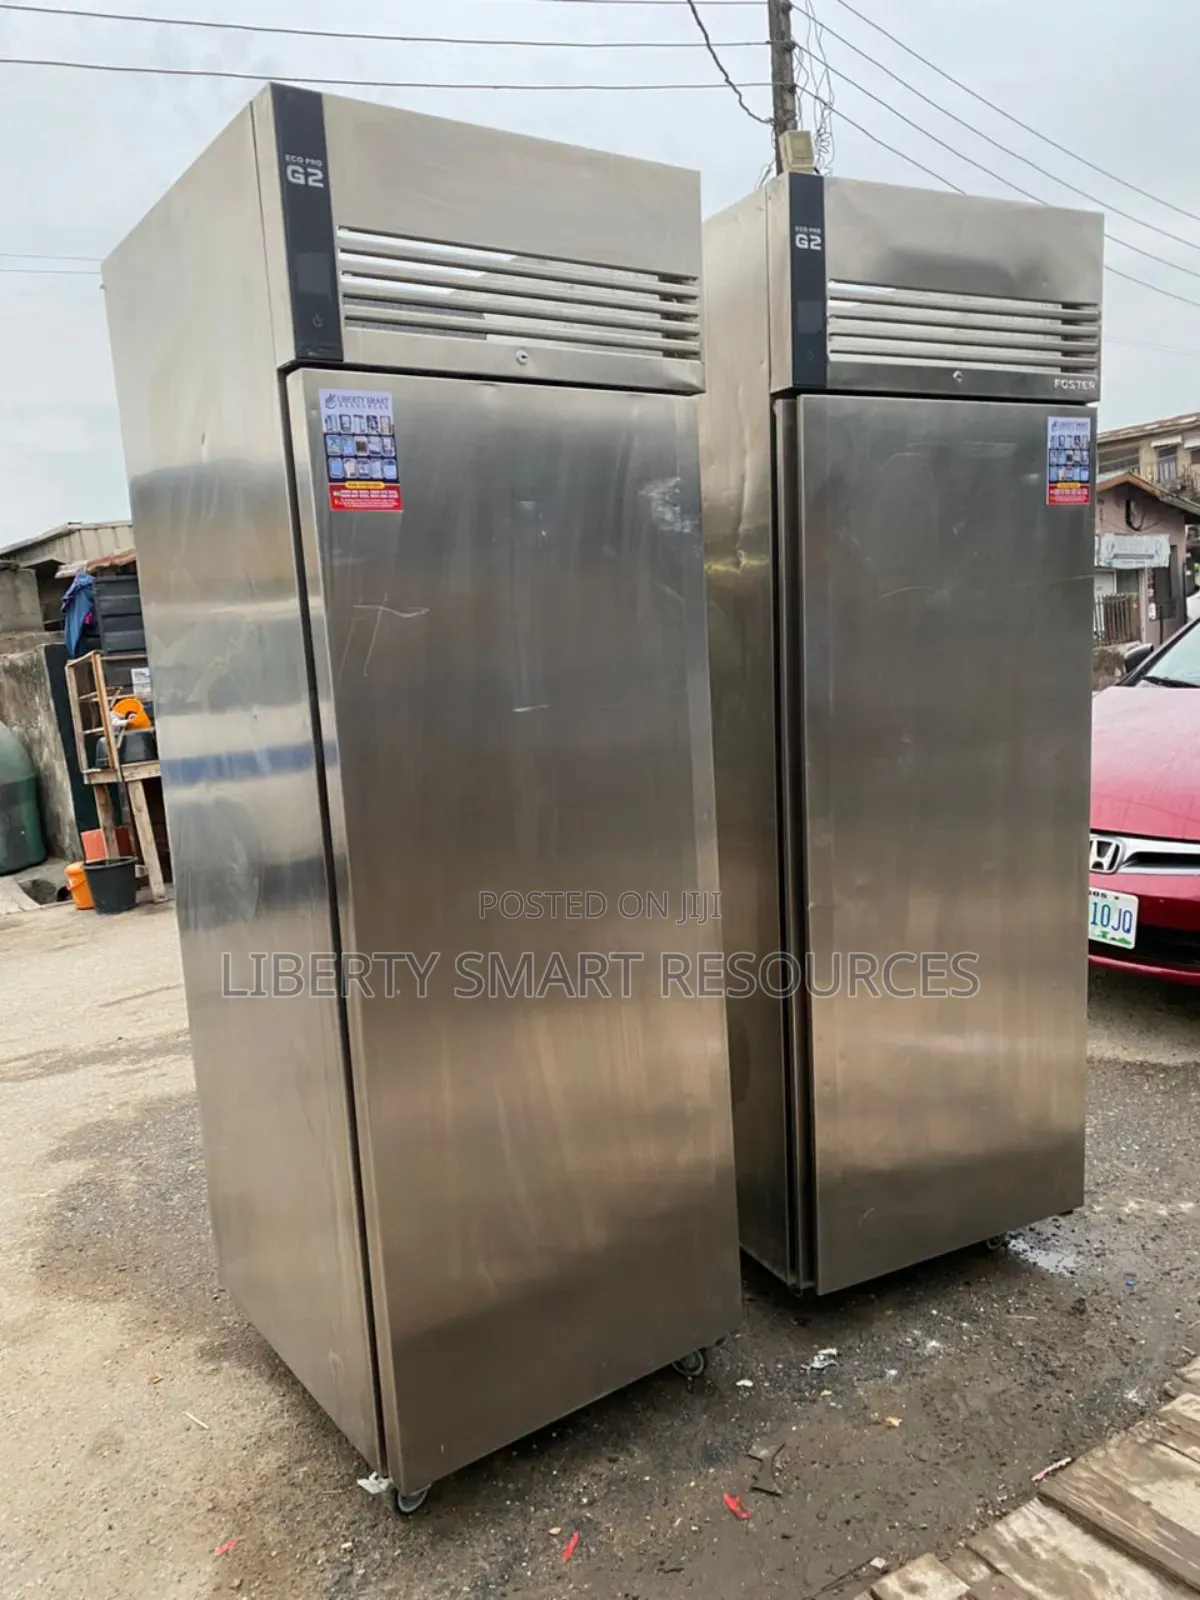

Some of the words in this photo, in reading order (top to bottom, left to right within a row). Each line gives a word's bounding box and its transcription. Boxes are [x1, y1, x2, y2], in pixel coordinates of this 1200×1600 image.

[285, 154, 304, 164] ECO
[305, 158, 323, 167] PRO
[286, 164, 325, 188] G2
[796, 234, 821, 250] G2
[1053, 378, 1097, 390] FOSTER
